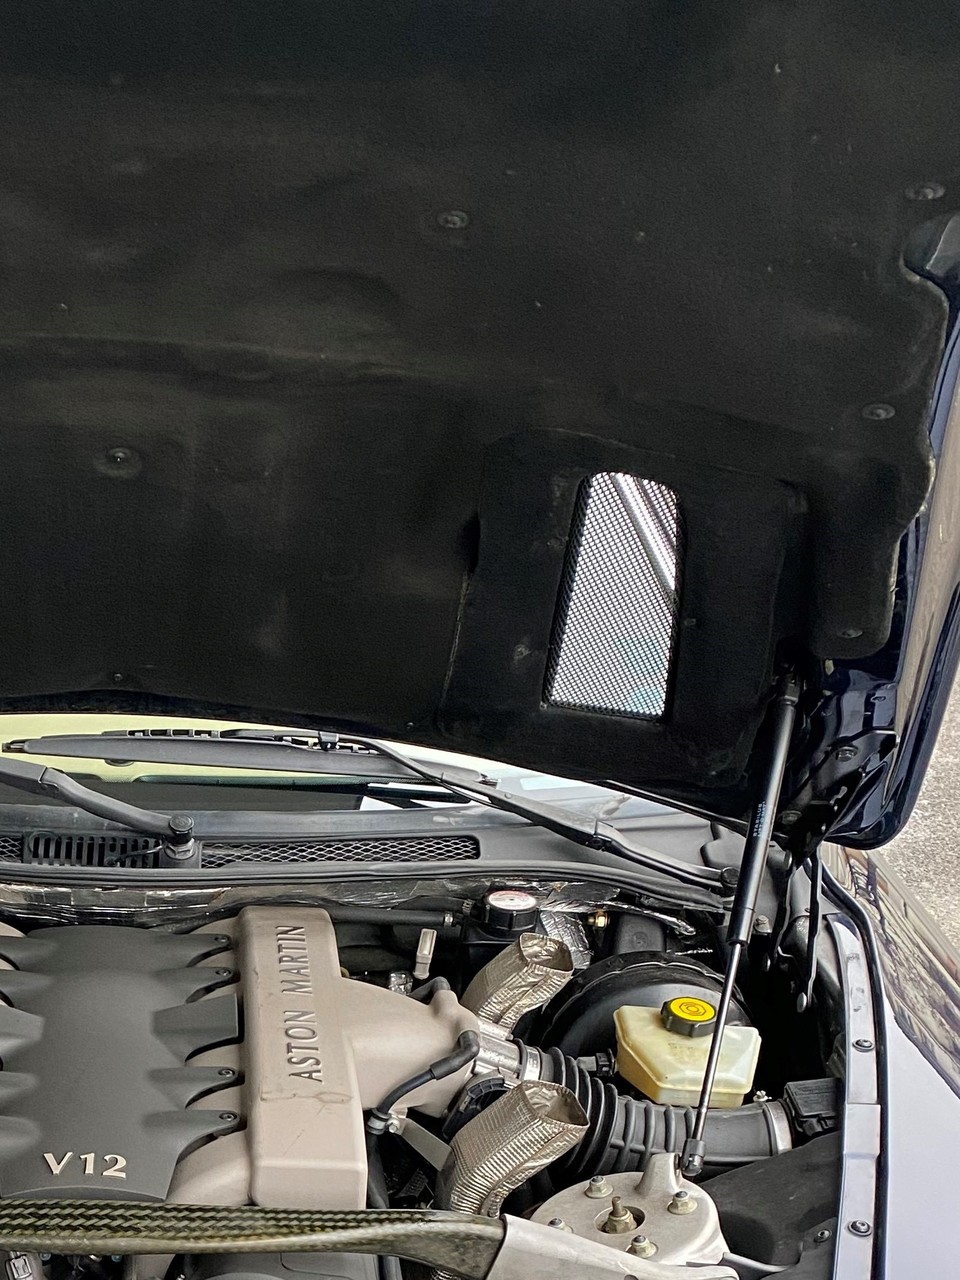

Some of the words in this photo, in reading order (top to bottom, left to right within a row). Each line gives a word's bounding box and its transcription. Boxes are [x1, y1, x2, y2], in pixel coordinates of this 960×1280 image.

[275, 925, 314, 996] MARTIN
[283, 1010, 324, 1084] ASTON
[43, 1151, 127, 1179] V12
